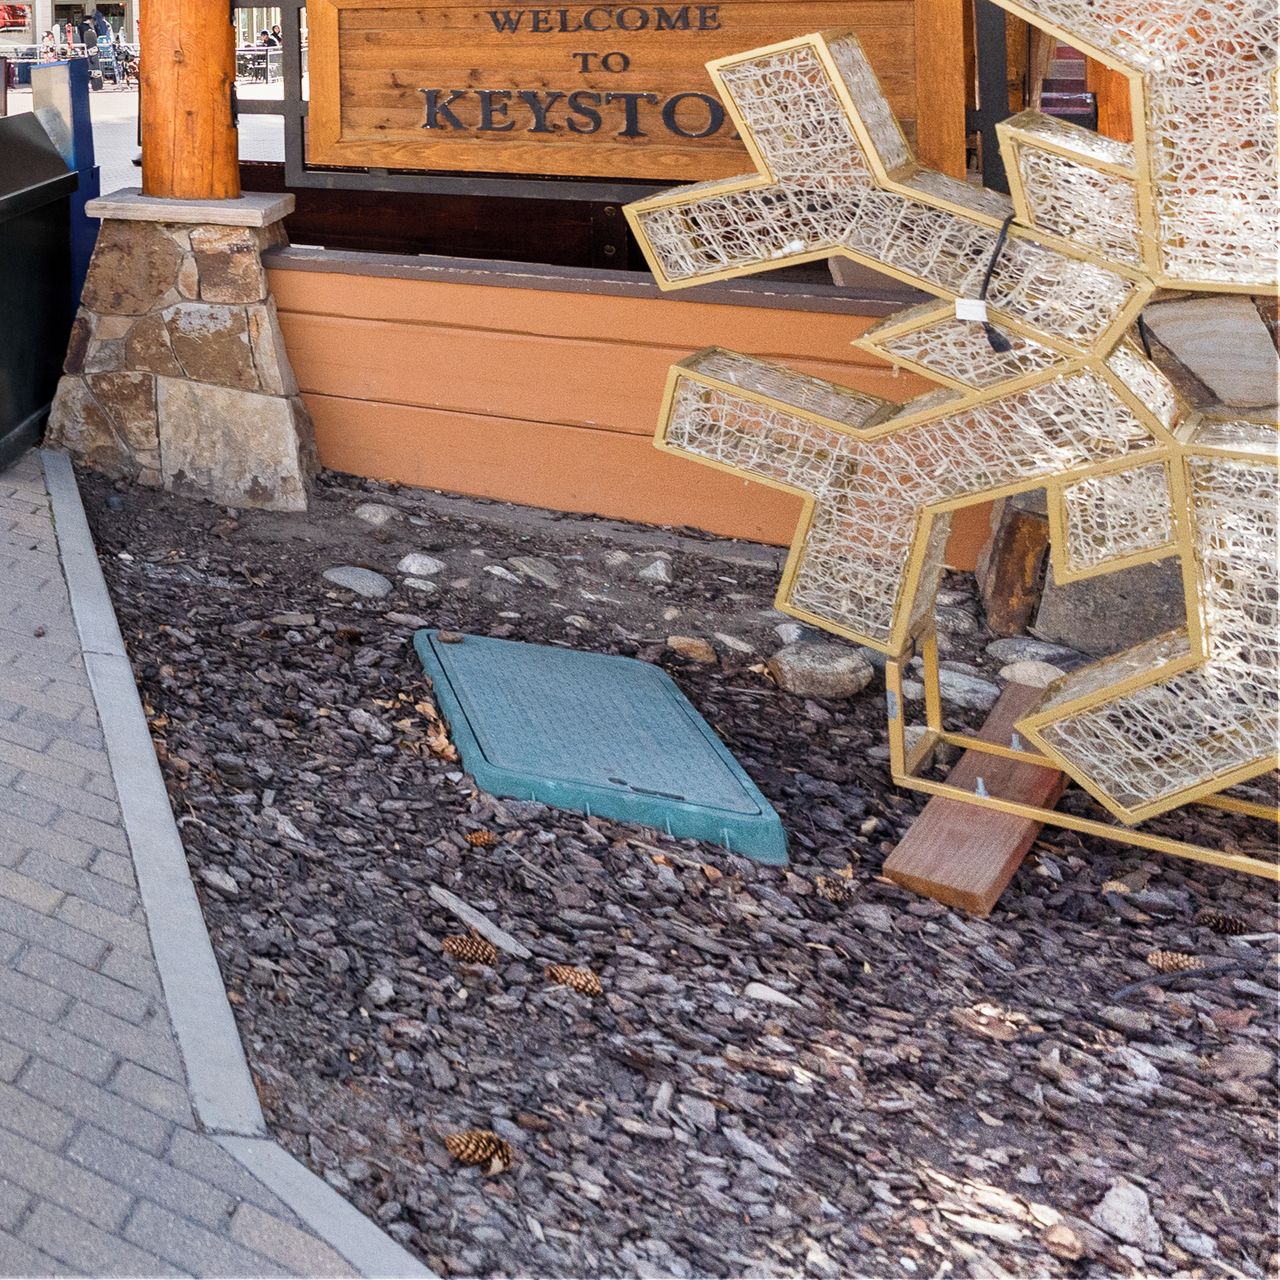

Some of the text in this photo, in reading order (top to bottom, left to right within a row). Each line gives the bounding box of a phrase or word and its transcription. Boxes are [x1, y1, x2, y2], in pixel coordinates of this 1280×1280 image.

[486, 5, 722, 34] WELCOME
[572, 51, 631, 74] TO
[418, 88, 743, 140] KEYSTO
